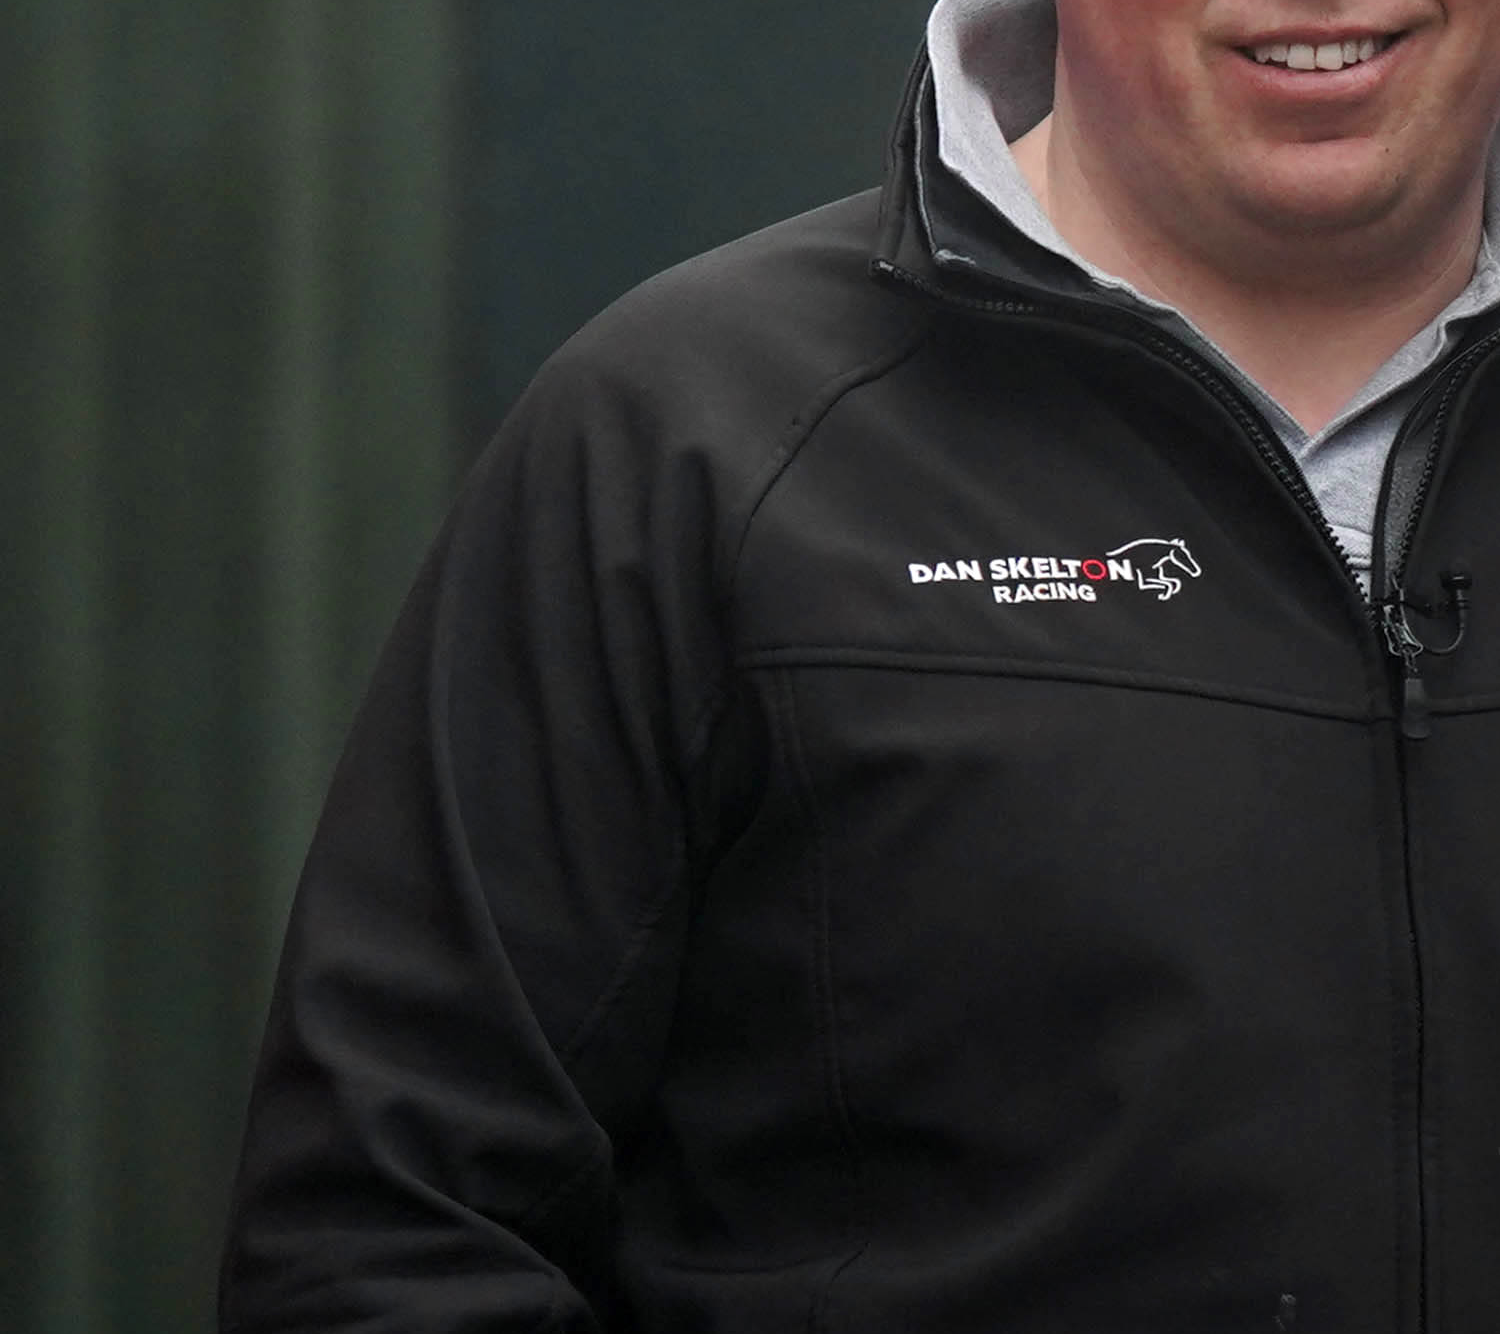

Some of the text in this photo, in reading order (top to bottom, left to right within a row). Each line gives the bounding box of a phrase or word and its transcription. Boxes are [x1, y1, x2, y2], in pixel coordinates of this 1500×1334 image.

[907, 556, 1135, 584] DAN SKELTON
[992, 581, 1097, 604] RACING
